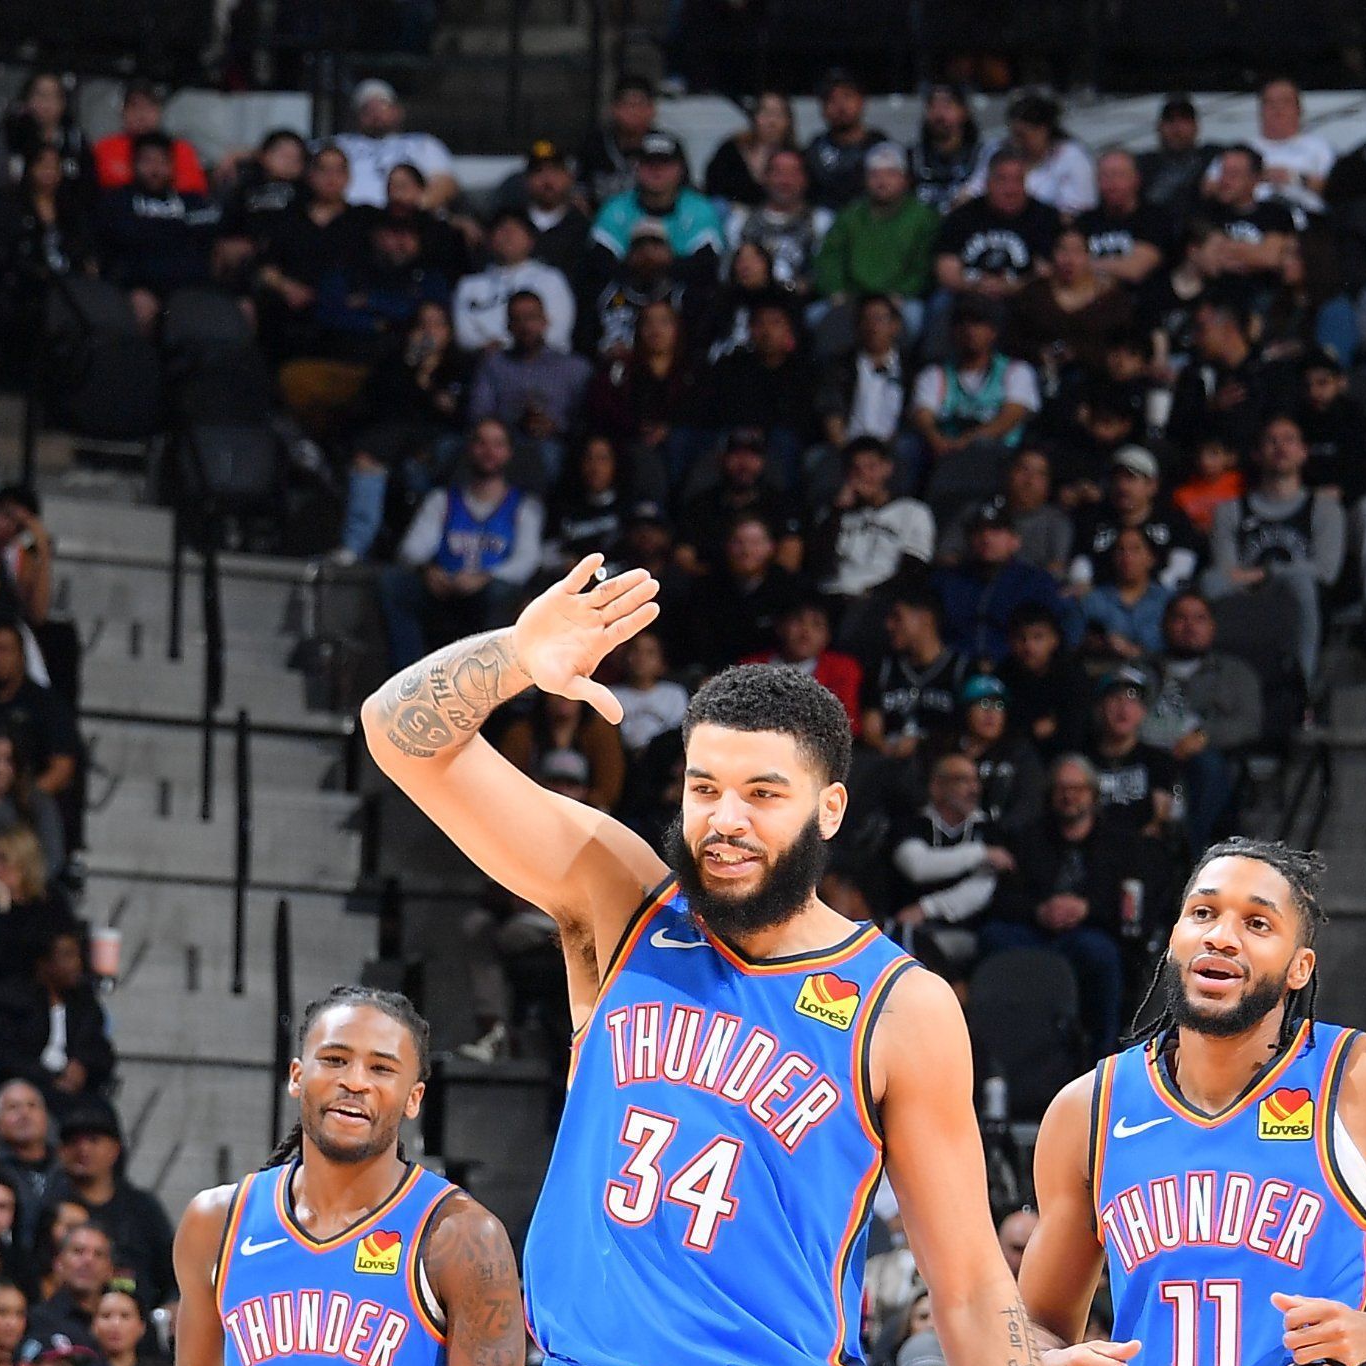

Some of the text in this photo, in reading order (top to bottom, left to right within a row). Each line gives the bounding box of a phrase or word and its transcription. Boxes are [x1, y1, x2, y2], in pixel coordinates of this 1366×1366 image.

[799, 995, 849, 1027] Love's
[604, 1002, 842, 1154] THUNDER
[1261, 1120, 1310, 1137] Love's
[604, 1105, 745, 1254] 34
[1100, 1170, 1326, 1274] THUNDER
[356, 1255, 396, 1272] Love's
